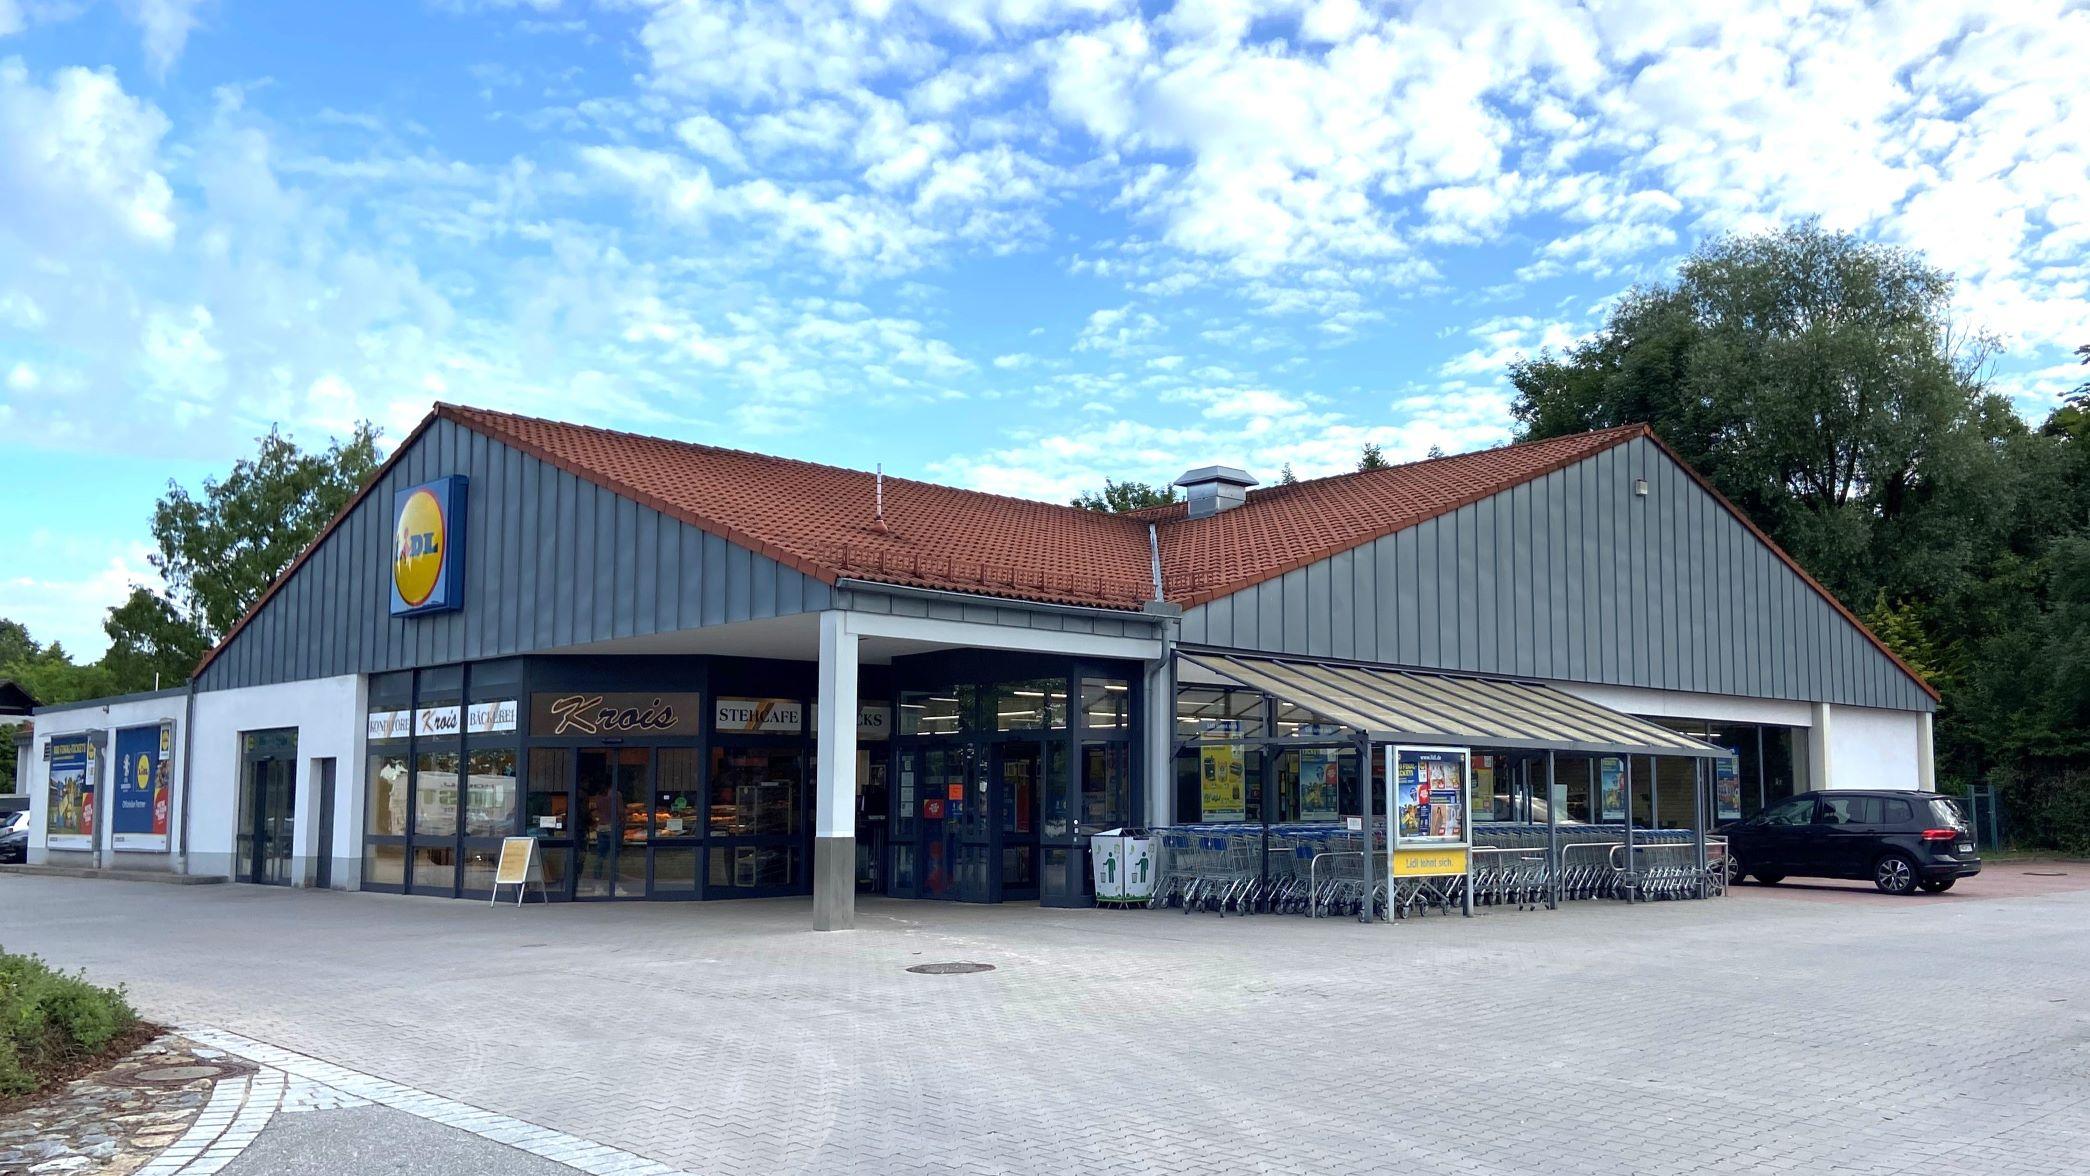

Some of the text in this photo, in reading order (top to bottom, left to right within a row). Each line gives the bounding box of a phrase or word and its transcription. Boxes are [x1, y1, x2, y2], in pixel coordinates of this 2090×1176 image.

[422, 709, 458, 733] Krois
[551, 695, 679, 734] Krois
[1406, 857, 1419, 869] Lidl
